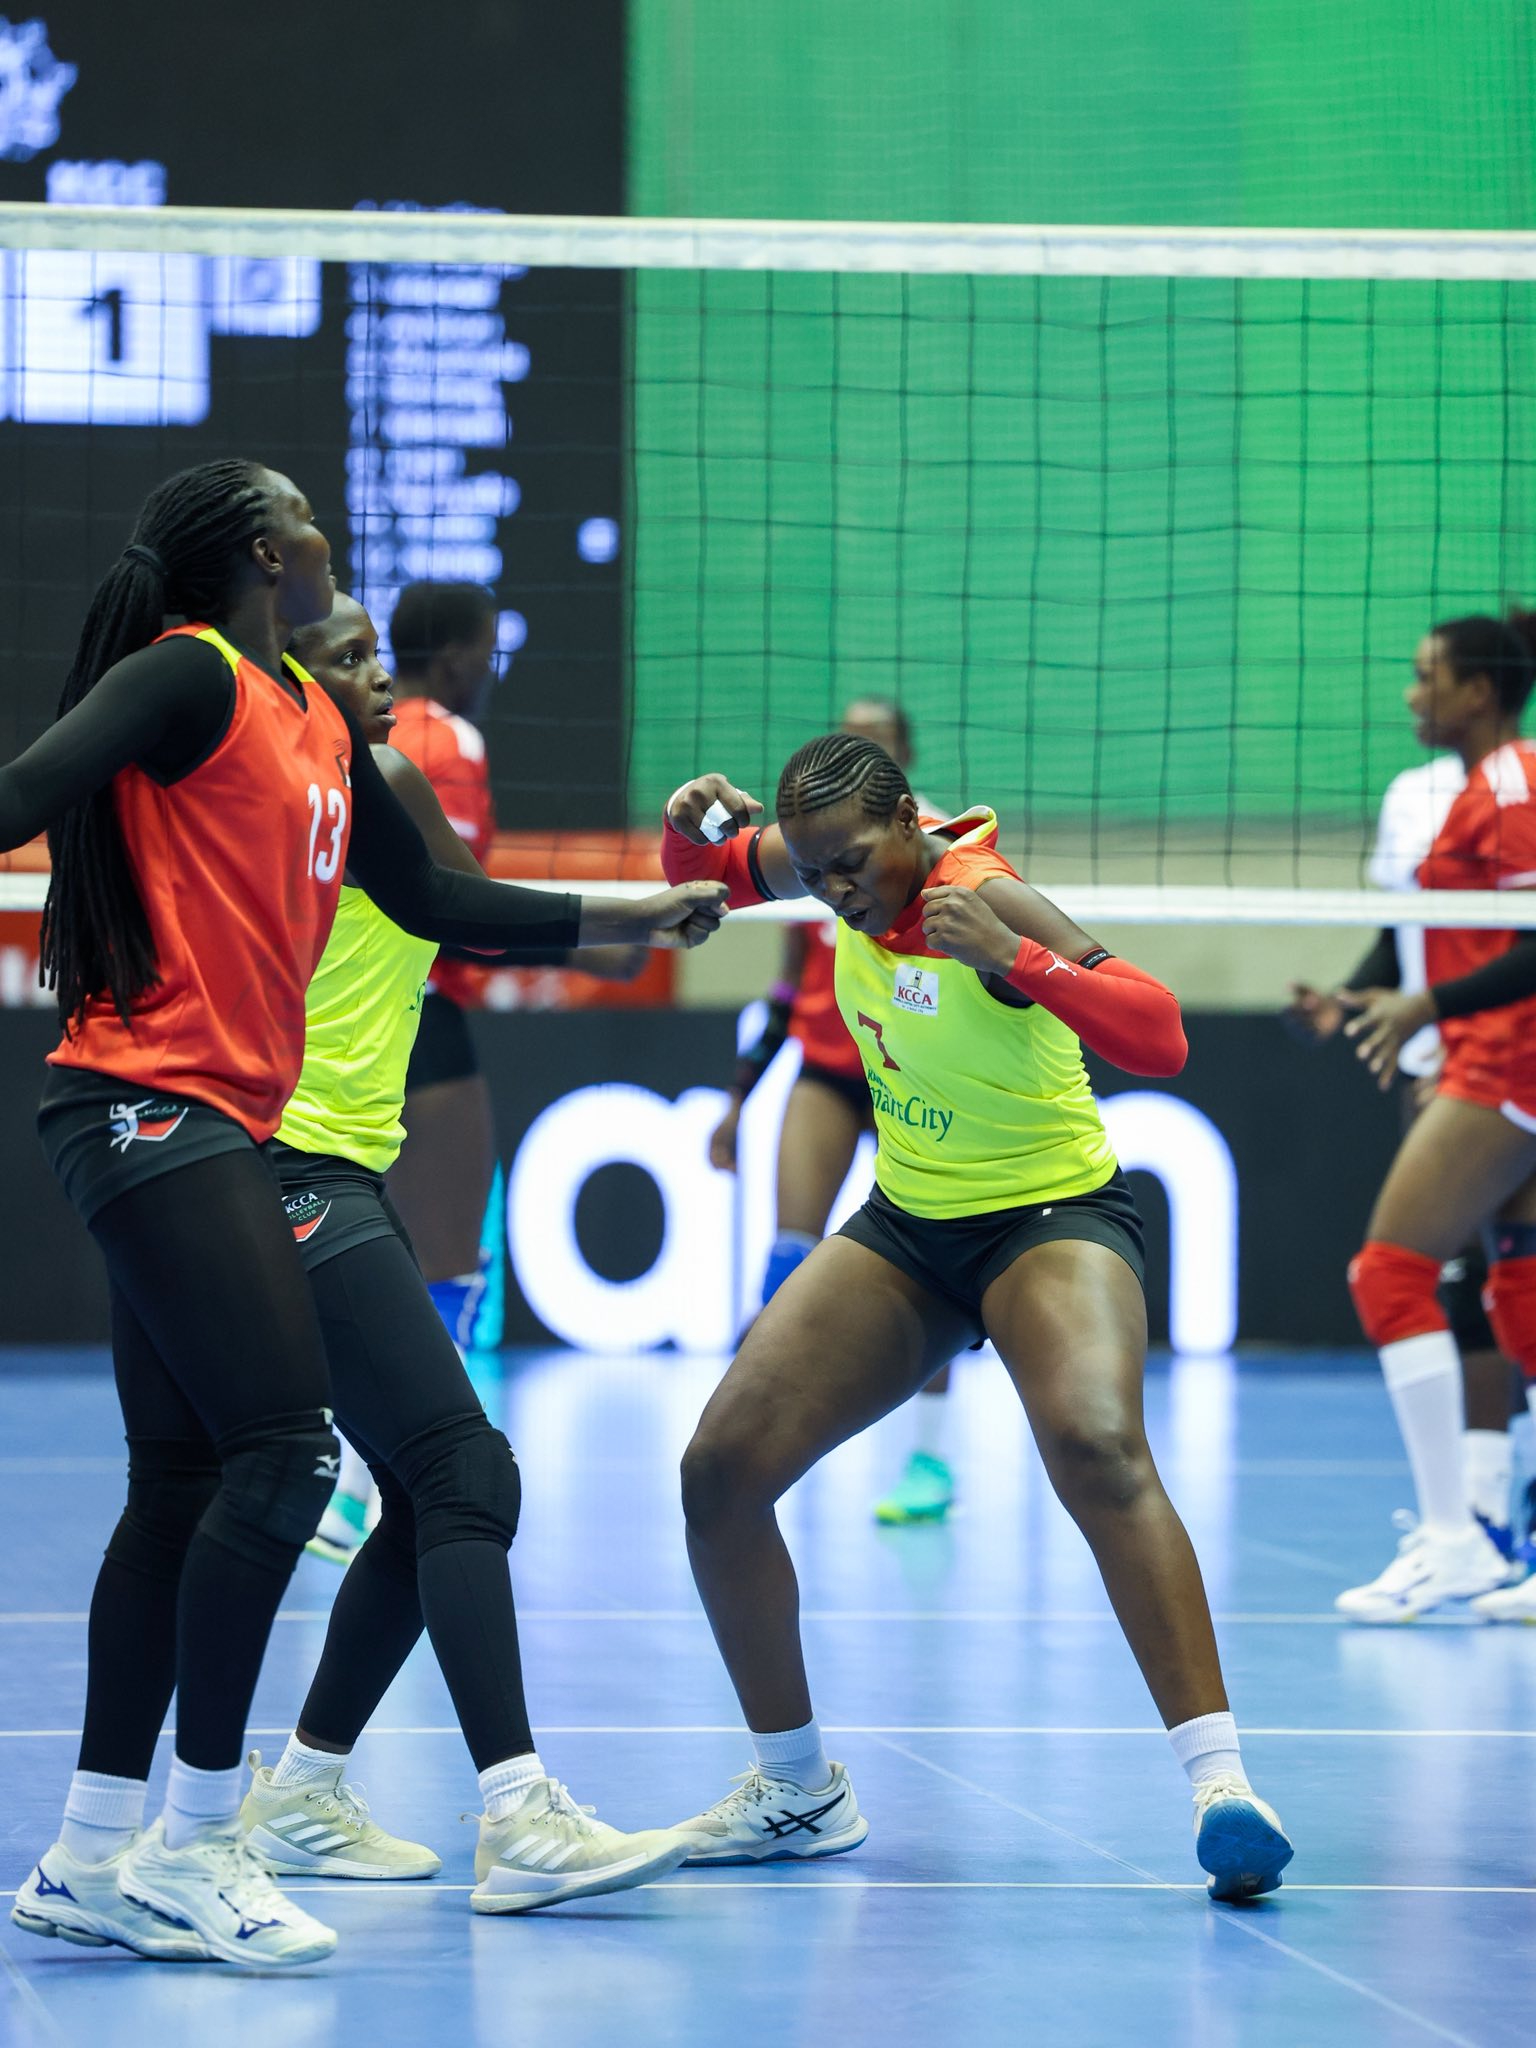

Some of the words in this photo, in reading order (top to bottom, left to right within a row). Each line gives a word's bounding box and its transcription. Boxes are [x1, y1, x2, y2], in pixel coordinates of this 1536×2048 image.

[81, 286, 124, 363] 1
[307, 783, 347, 884] 13
[897, 985, 933, 1006] KCCA
[857, 1010, 902, 1072] 7
[869, 1086, 954, 1142] martCity
[285, 1192, 318, 1213] KCCA
[298, 1209, 317, 1221] CLUB
